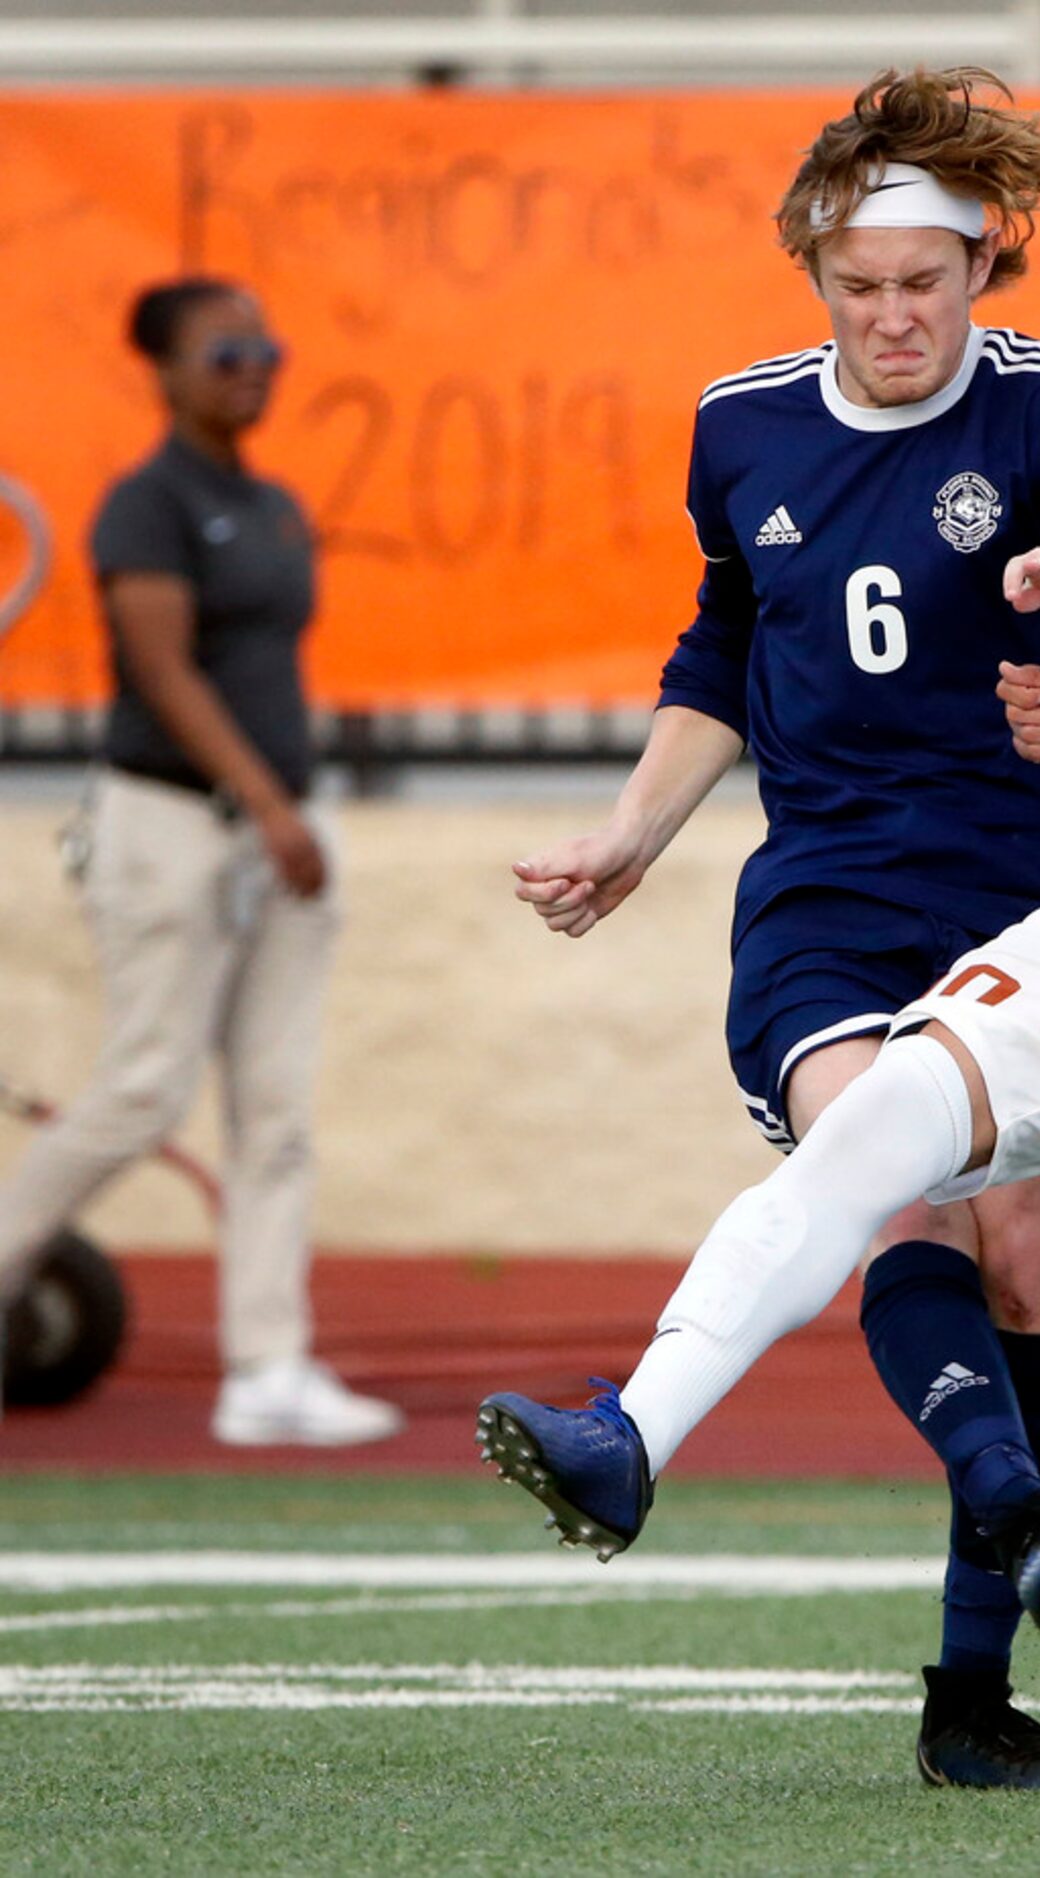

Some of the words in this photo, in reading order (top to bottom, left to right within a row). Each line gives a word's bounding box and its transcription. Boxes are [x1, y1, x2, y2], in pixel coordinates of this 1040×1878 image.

[303, 369, 648, 567] 2019
[755, 530, 803, 546] adidas
[846, 564, 908, 674] 6
[920, 1376, 990, 1421] adidas
